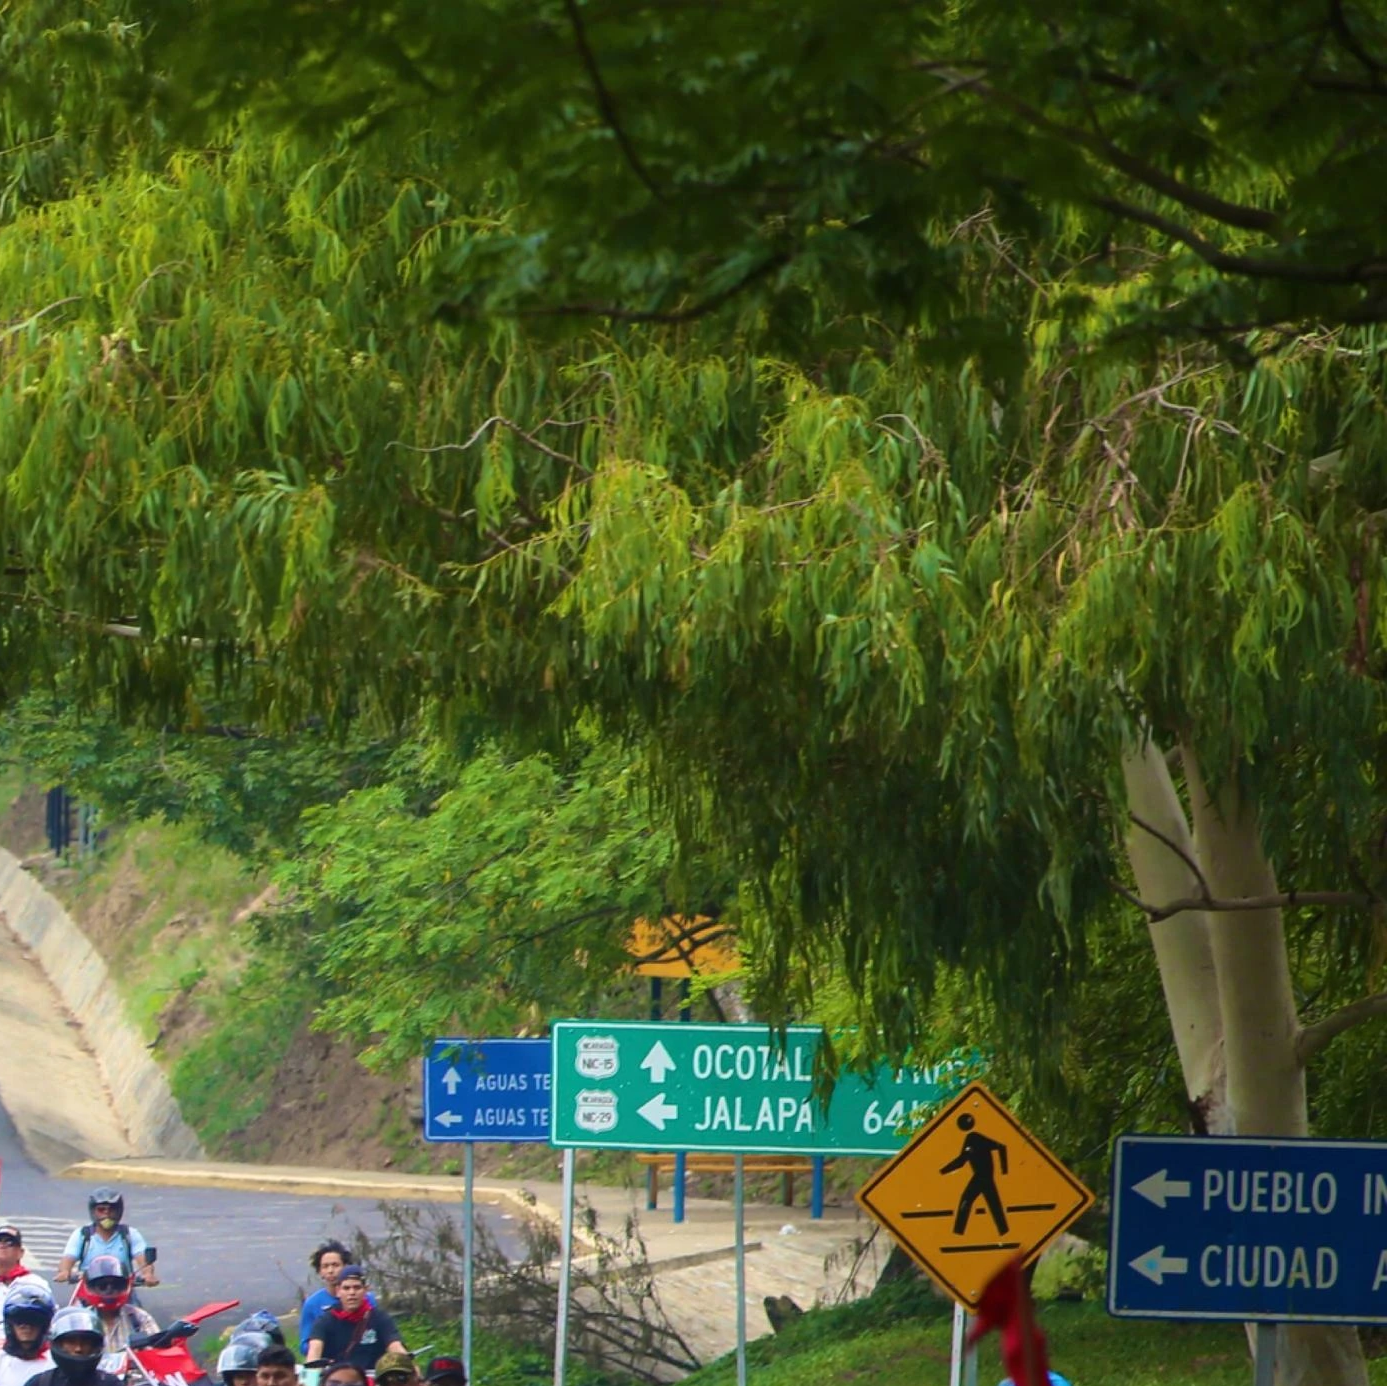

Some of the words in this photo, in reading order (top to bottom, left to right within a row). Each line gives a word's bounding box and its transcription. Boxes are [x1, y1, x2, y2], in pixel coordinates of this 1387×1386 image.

[581, 1058, 614, 1070] NIC-15
[693, 1044, 812, 1082] OCOTAL
[475, 1074, 527, 1091] AGUAS
[473, 1108, 526, 1126] AGUAS
[694, 1096, 815, 1133] JALAPA
[1203, 1169, 1338, 1215] PUEBLO
[1200, 1244, 1339, 1289] CIUDAD
